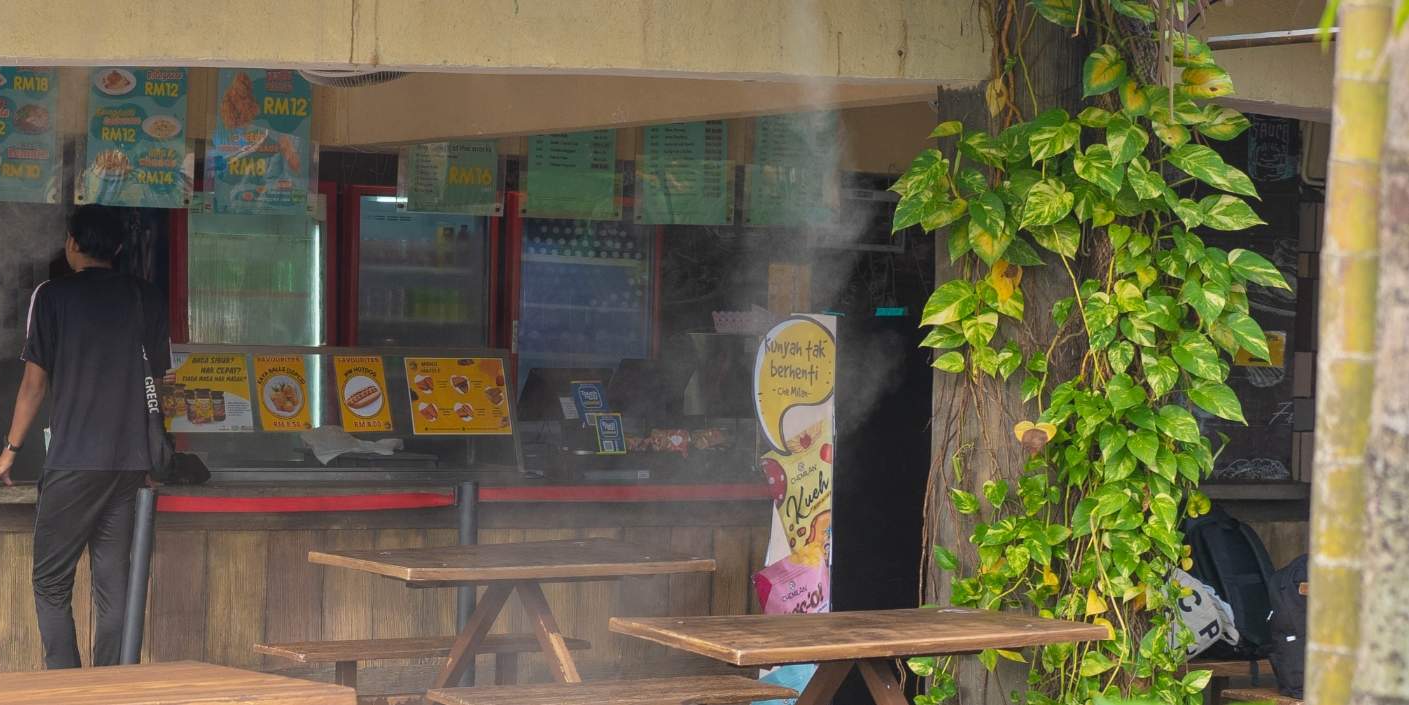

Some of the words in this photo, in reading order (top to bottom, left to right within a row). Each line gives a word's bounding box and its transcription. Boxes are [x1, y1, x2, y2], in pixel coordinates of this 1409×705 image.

[14, 76, 49, 92] RM18
[144, 82, 180, 97] RM12
[264, 96, 308, 116] RM12
[102, 127, 136, 142] RM12
[228, 157, 267, 176] RM8
[138, 170, 174, 185] RM14
[765, 338, 802, 358] Kunyah
[806, 340, 827, 361] tak
[770, 360, 819, 386] berhenti
[786, 470, 829, 525] Kueh
